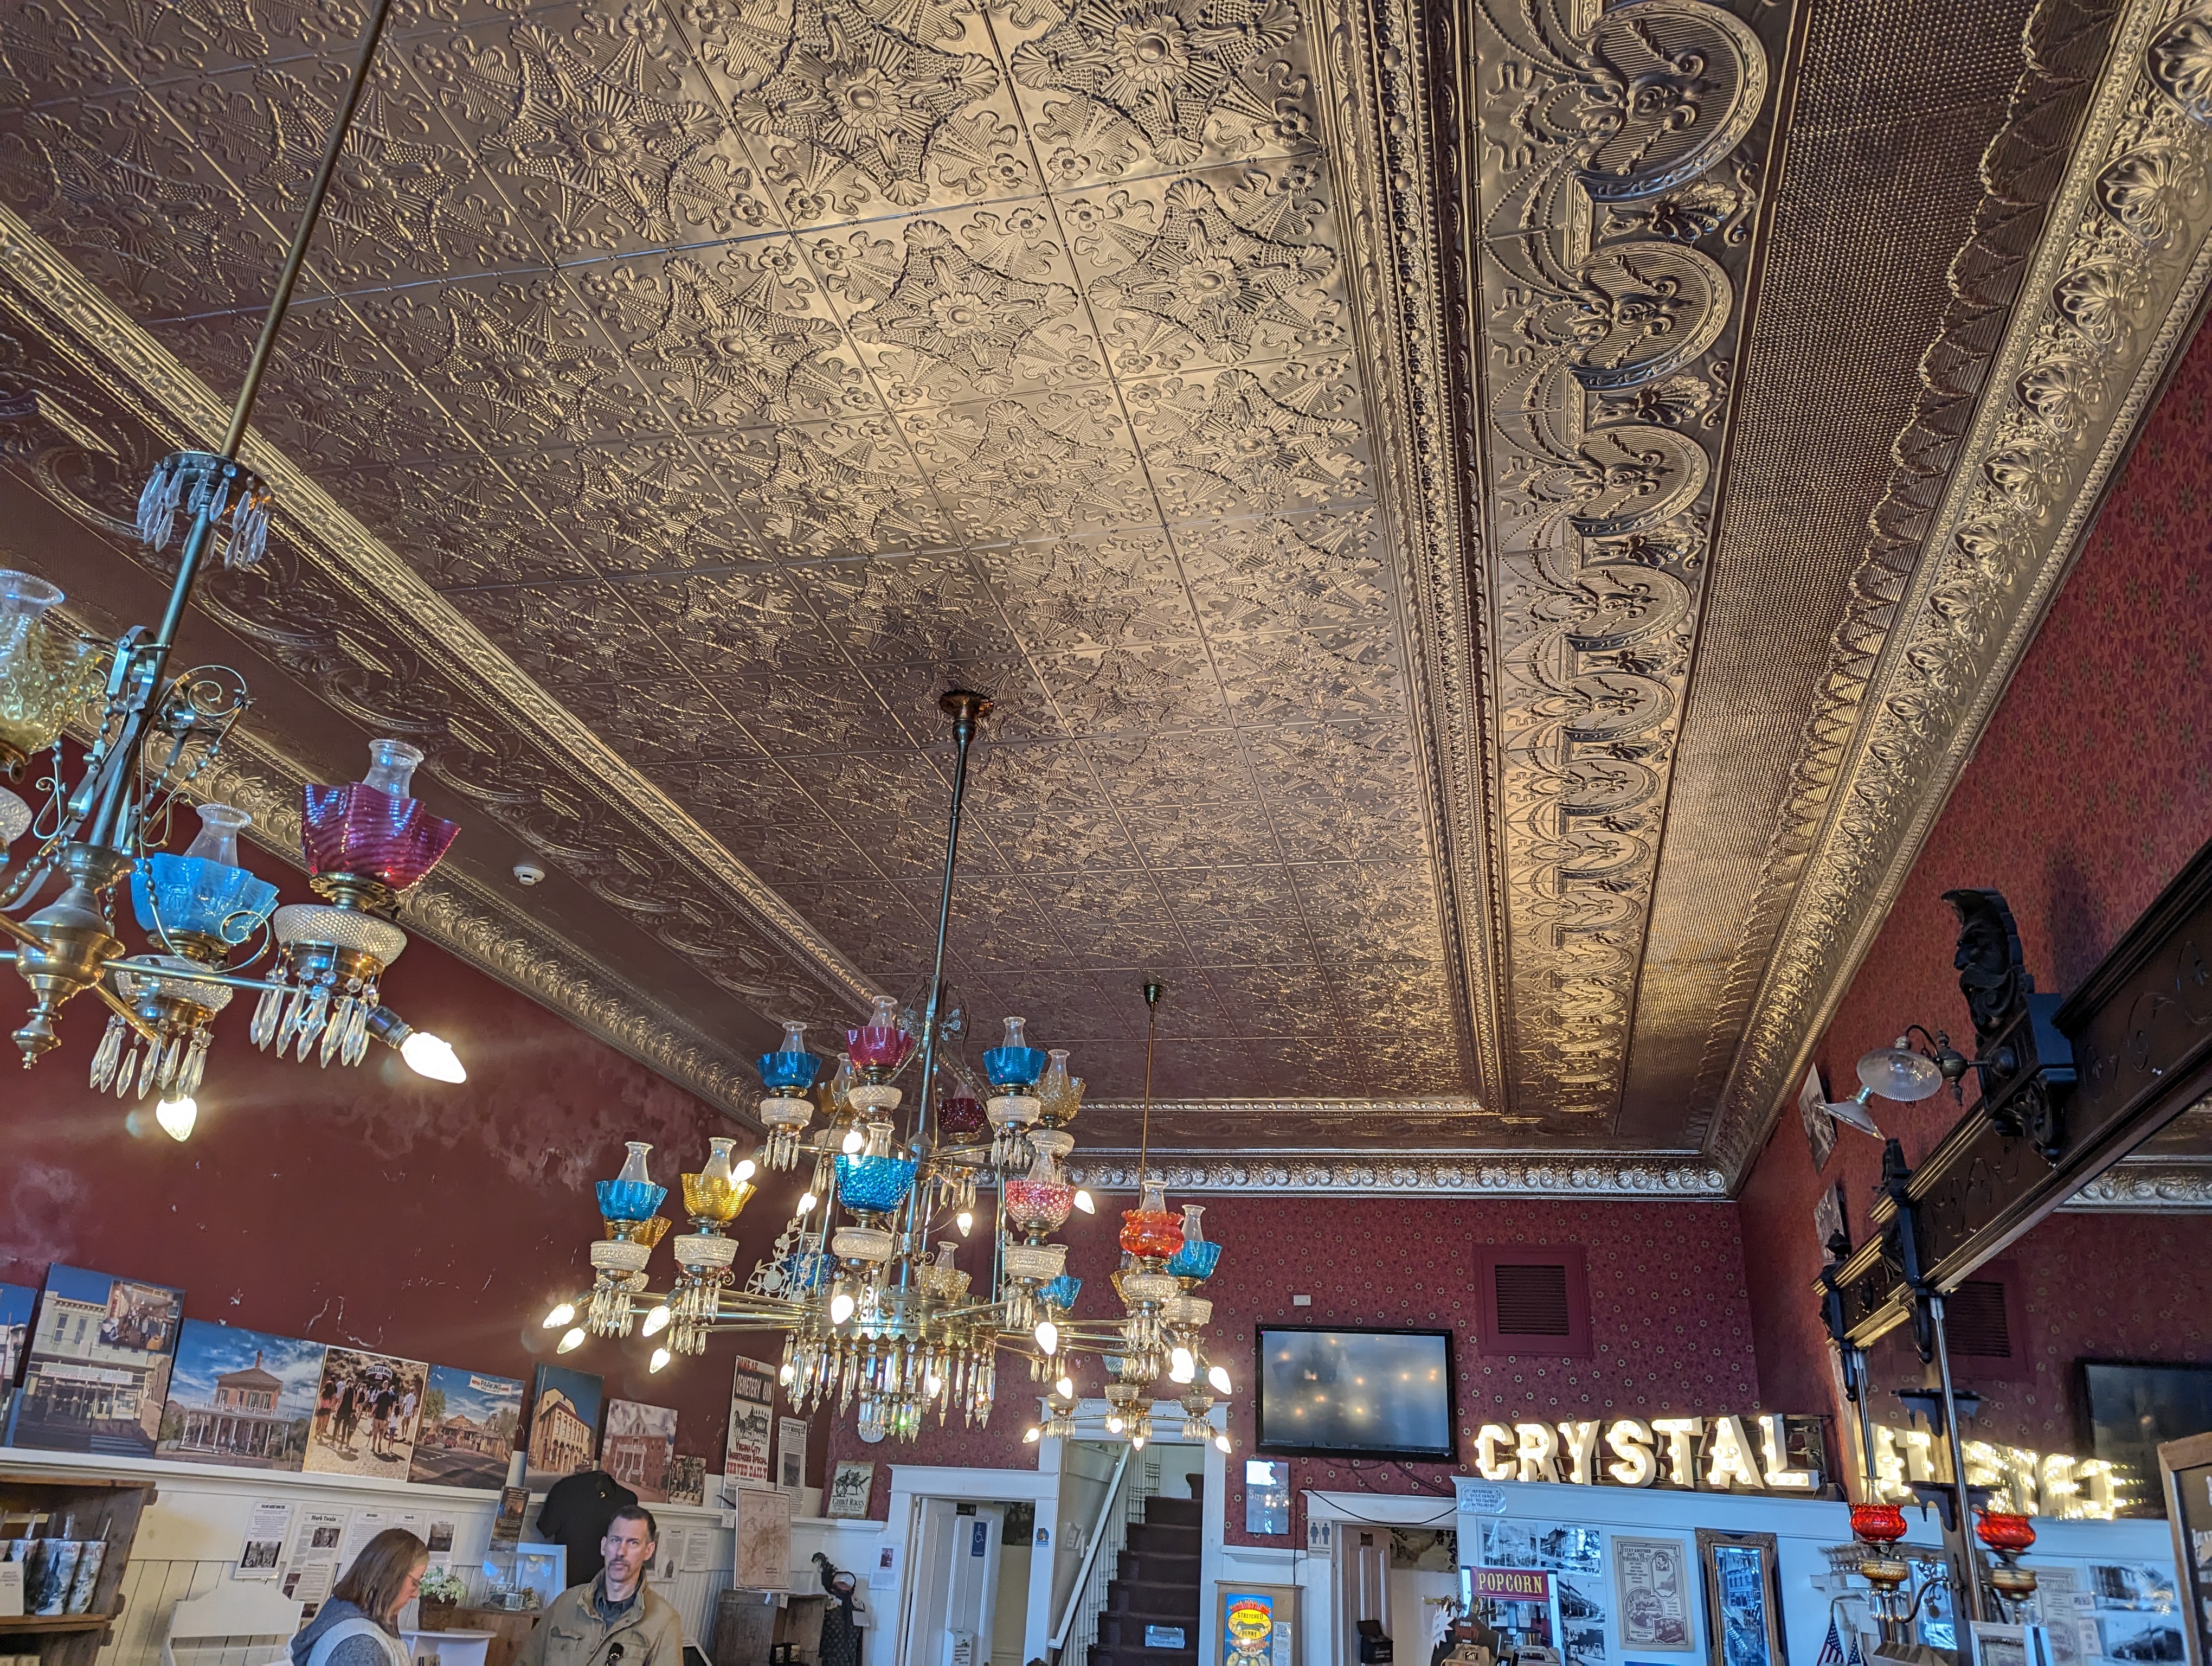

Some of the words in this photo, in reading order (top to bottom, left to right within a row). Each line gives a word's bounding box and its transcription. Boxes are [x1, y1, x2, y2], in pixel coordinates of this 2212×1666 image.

[480, 1380, 501, 1390] PARKING
[736, 1374, 761, 1399] CEMETERY
[763, 1381, 773, 1402] GIN
[751, 1441, 761, 1455] CITY
[1474, 1413, 1820, 1491] CRYSTAL
[726, 1462, 748, 1476] SERVED
[749, 1465, 767, 1479] DAILY
[1477, 1573, 1542, 1593] POPCORN
